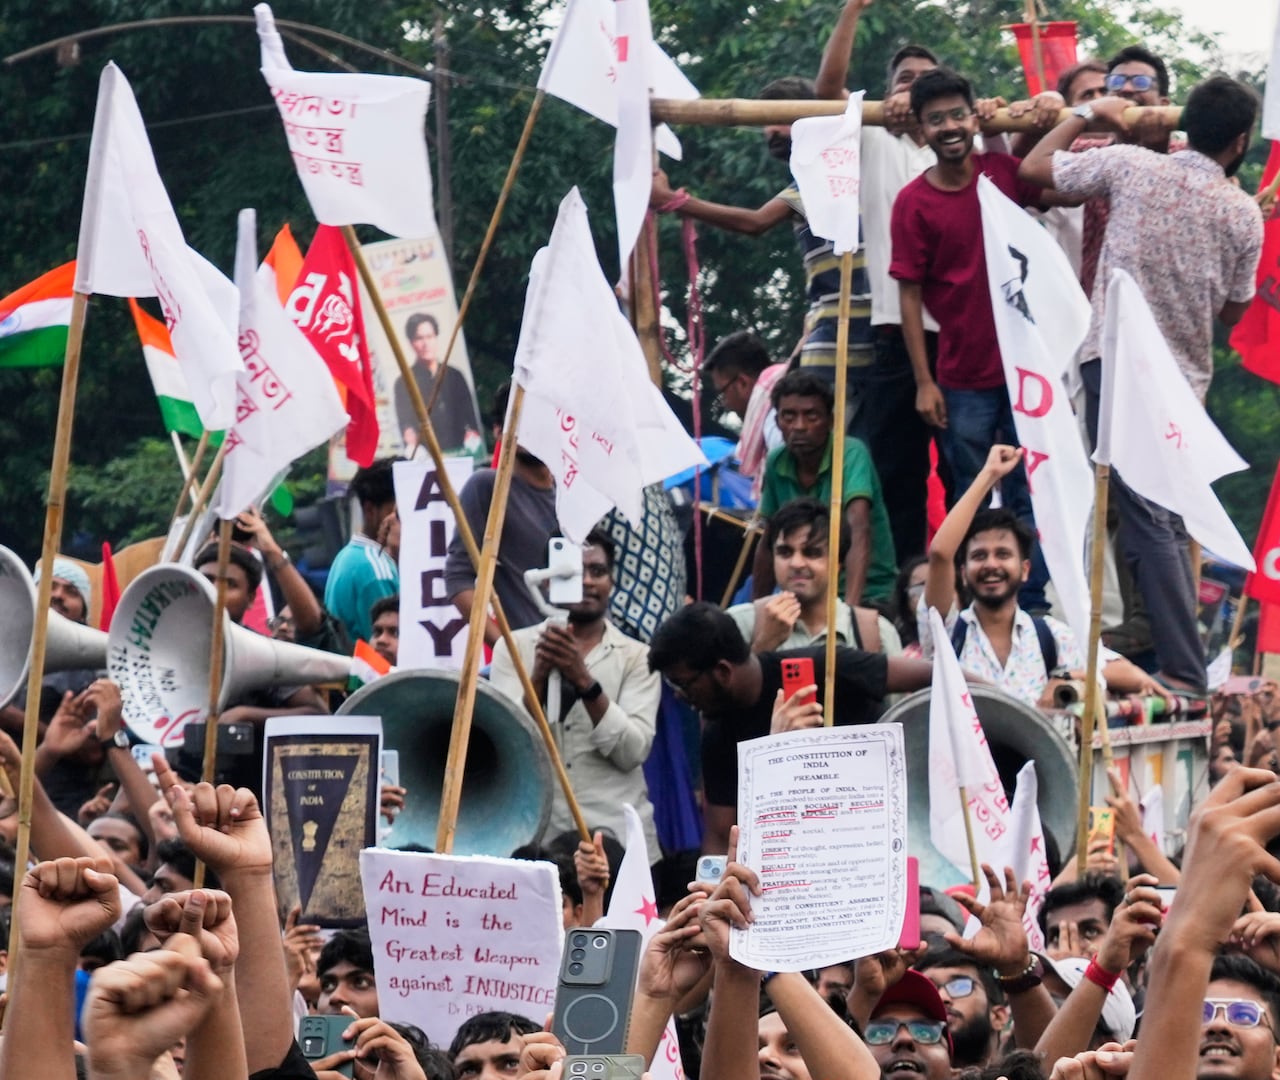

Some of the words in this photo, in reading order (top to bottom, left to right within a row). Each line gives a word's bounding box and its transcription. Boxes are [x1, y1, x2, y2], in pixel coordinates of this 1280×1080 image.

[787, 751, 852, 762] CONSTITUTION
[379, 870, 414, 893] An
[421, 873, 518, 900] Educated
[762, 879, 807, 887] FRATERNITY
[795, 900, 843, 909] CONSTITUENT
[849, 896, 884, 904] ASSEMBLY
[381, 907, 427, 927] Mind
[446, 912, 460, 928] is
[481, 913, 513, 930] the
[386, 940, 464, 963] Greatest
[474, 947, 540, 971] Weapon
[389, 975, 454, 997] against
[464, 975, 555, 1006] INJUSTICE
